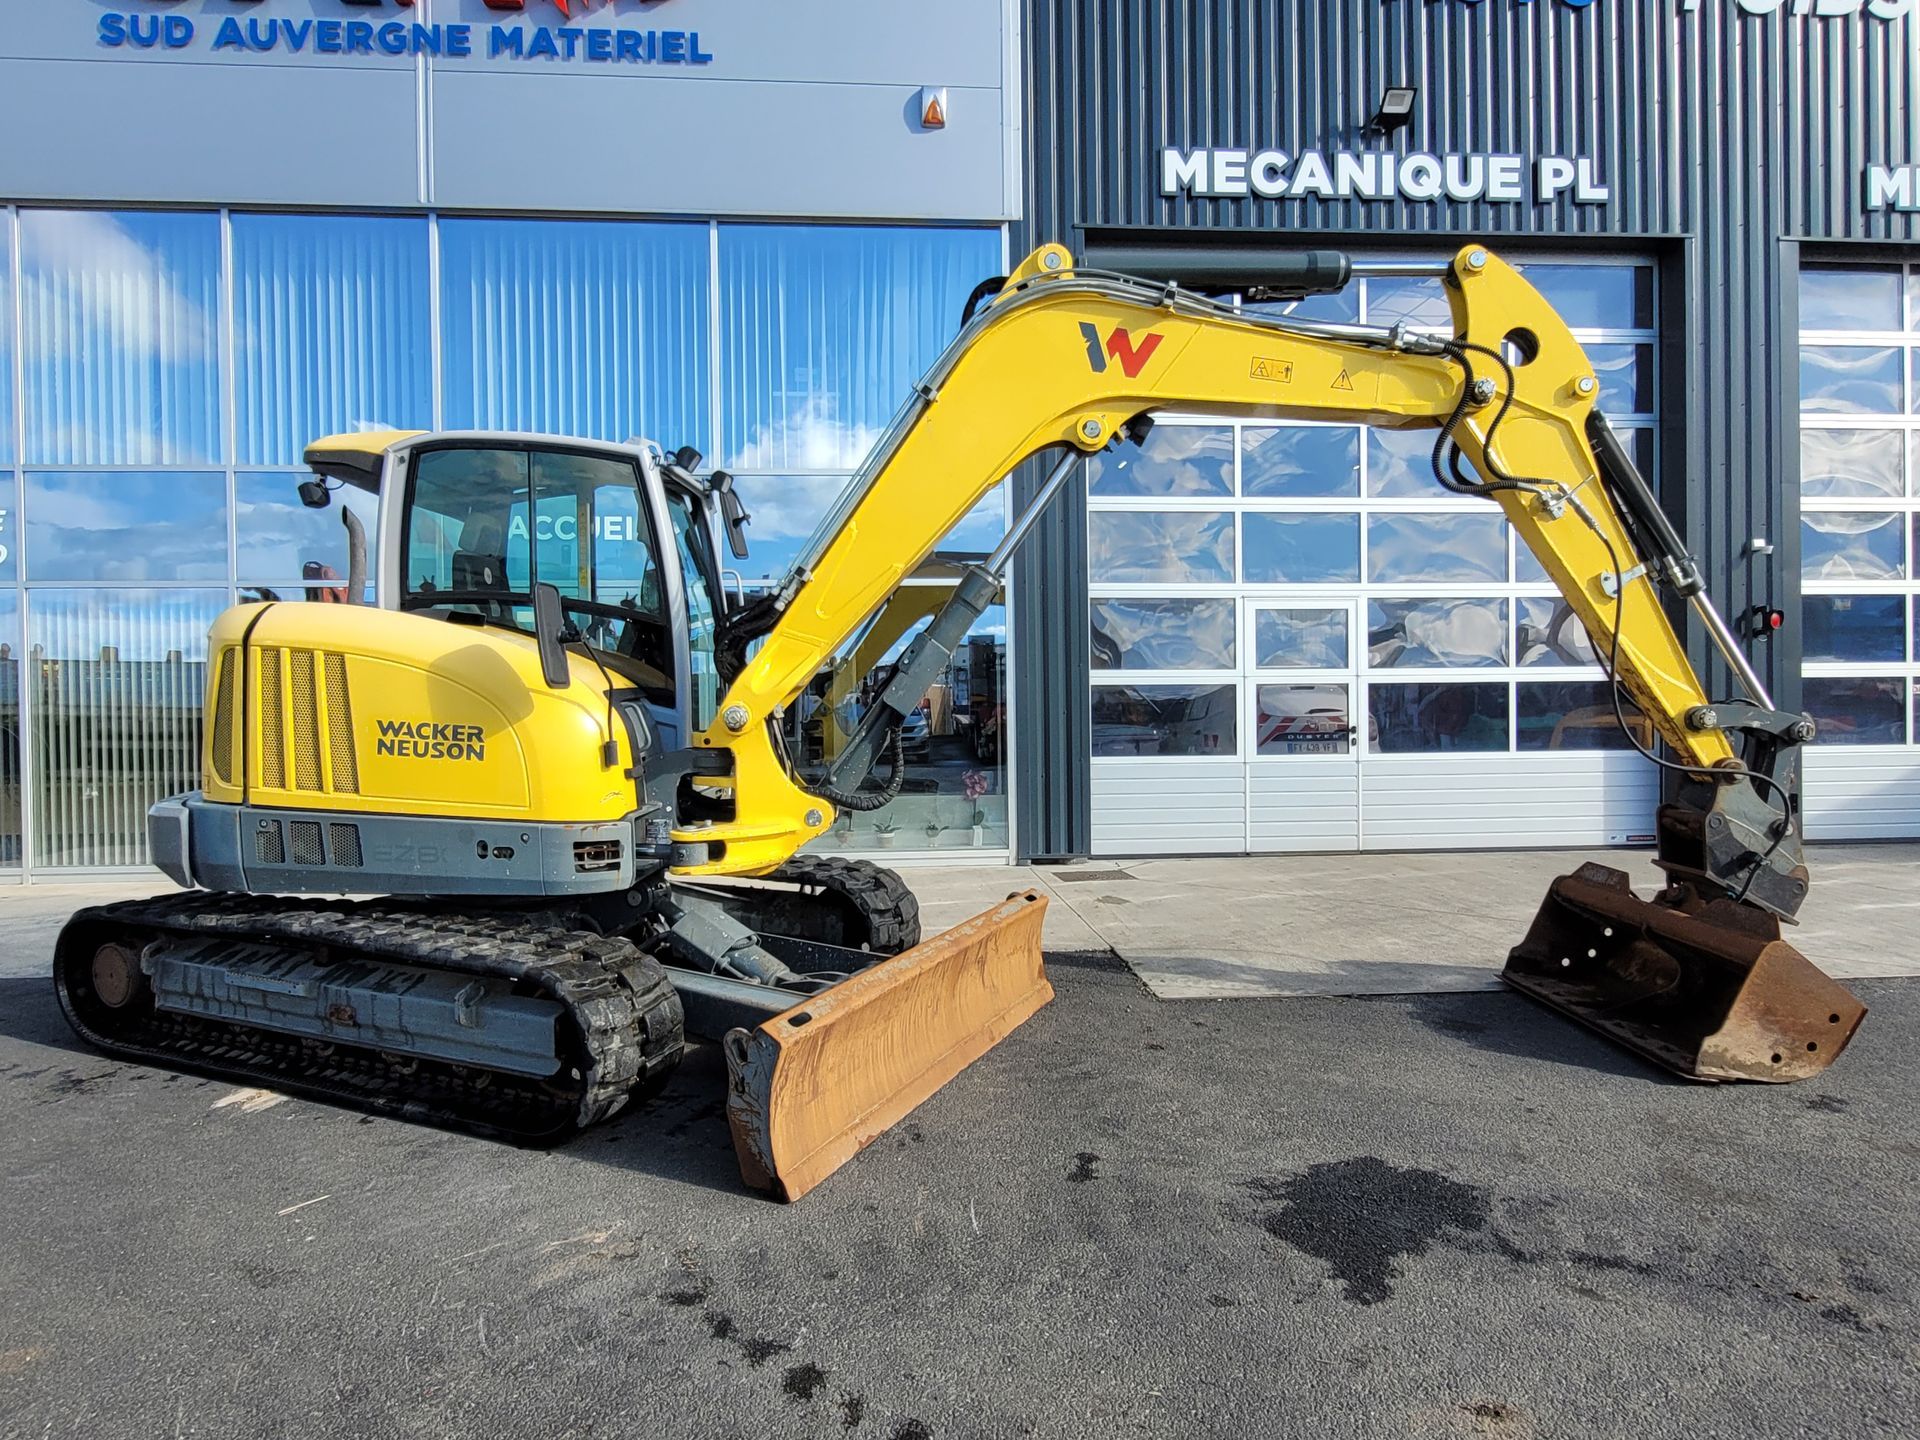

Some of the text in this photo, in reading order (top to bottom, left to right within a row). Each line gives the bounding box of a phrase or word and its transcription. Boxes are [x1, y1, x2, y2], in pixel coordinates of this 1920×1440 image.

[99, 12, 713, 62] SUD AUVERGNE MATERIEL
[1163, 149, 1609, 201] MECANIQUE PL
[1870, 166, 1920, 207] M
[376, 719, 485, 743] WACKER
[376, 738, 485, 761] NEUSON
